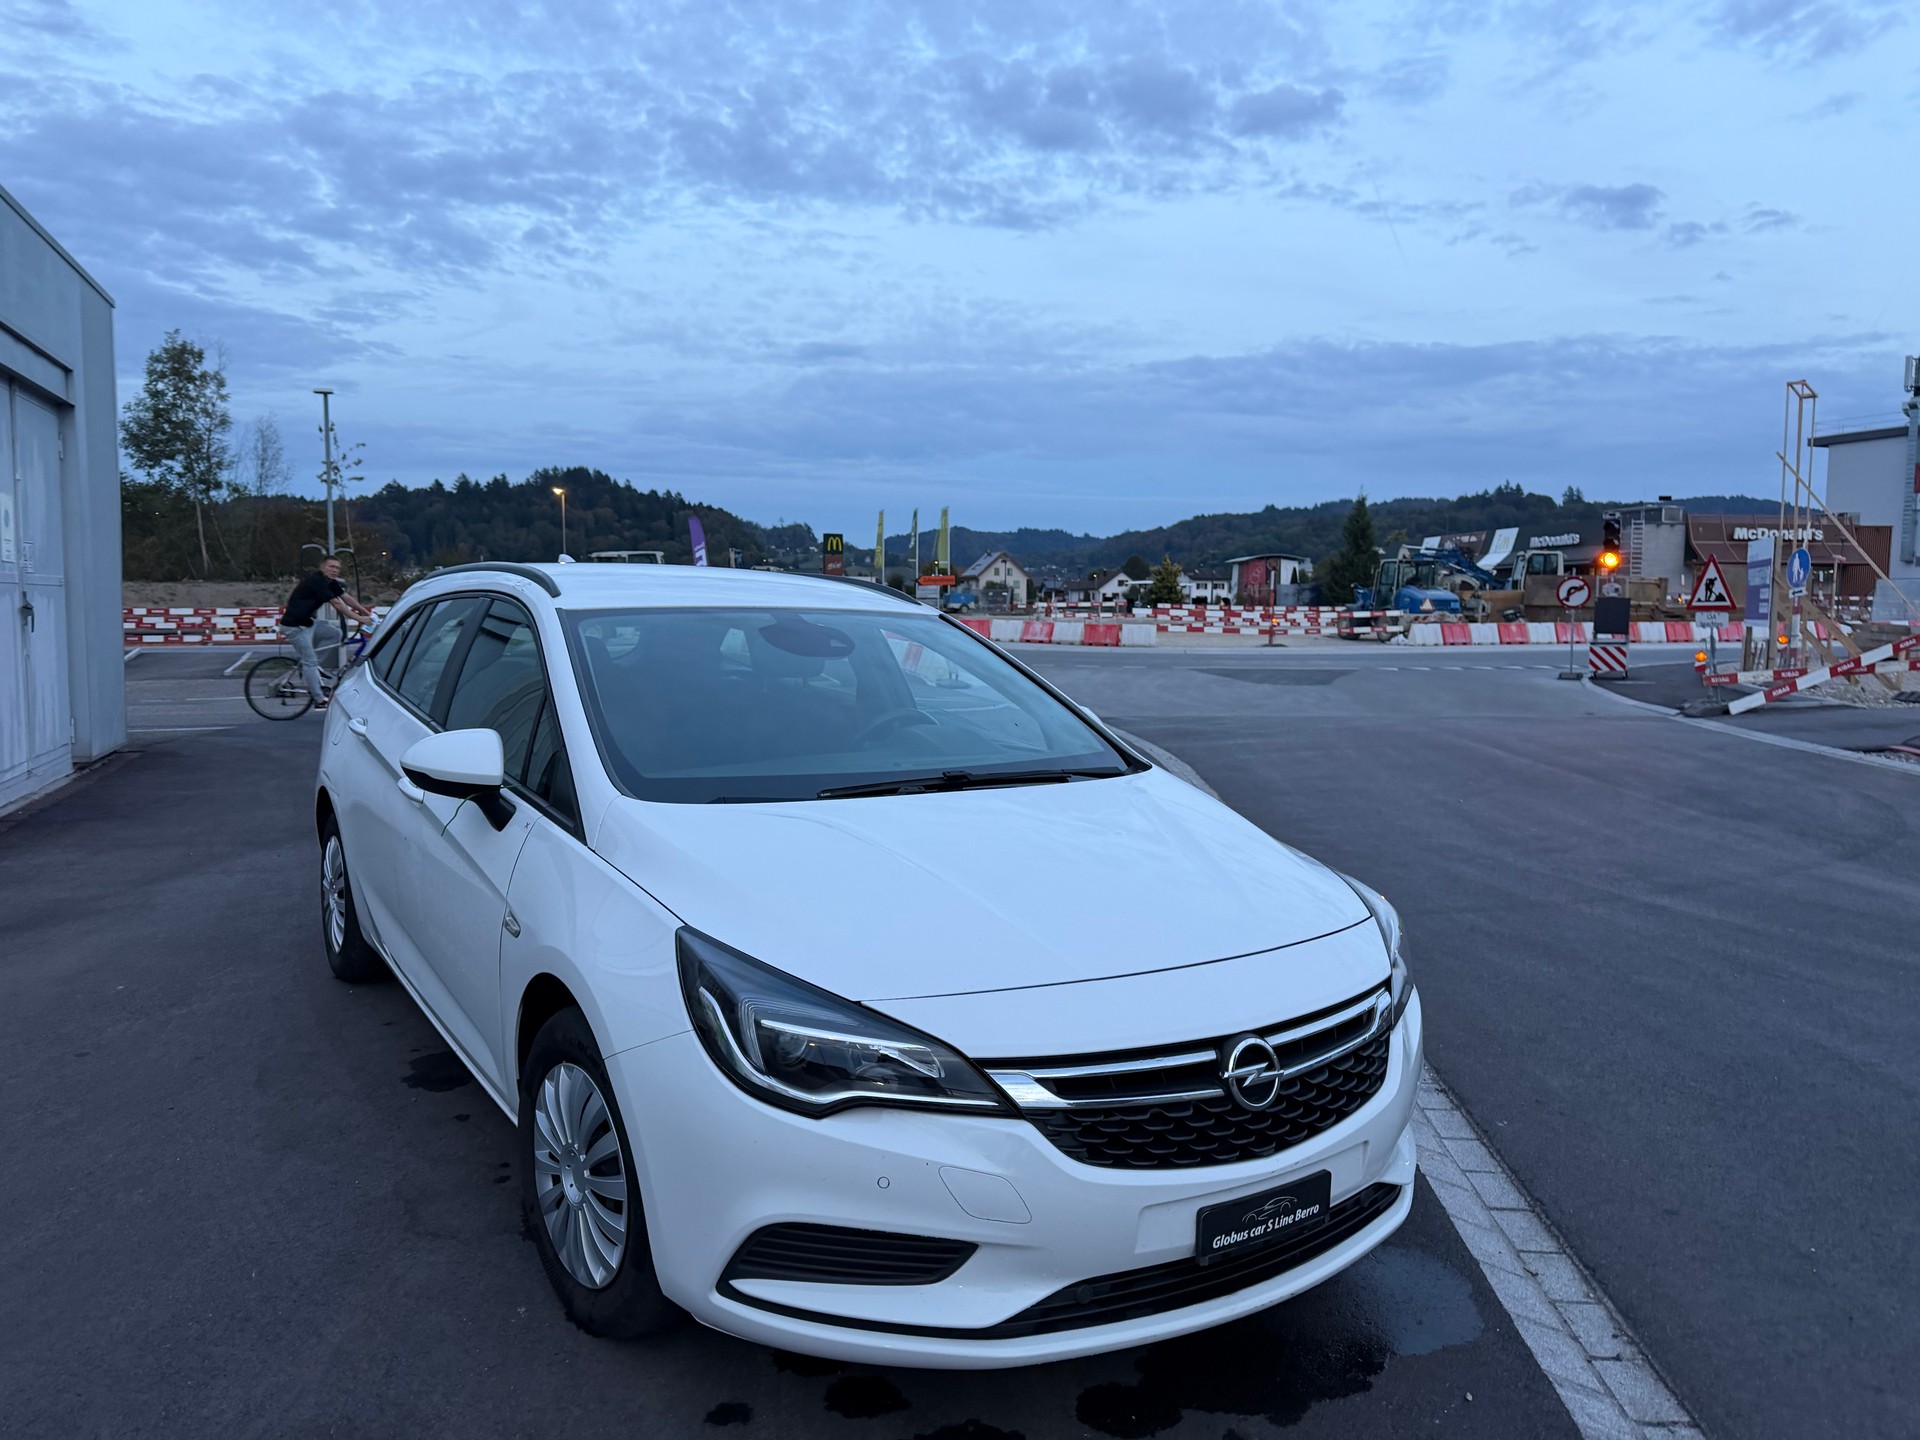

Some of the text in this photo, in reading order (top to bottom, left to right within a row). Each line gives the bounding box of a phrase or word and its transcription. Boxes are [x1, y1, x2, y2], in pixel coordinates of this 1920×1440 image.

[1733, 527, 1823, 541] McDonald's
[1212, 1204, 1320, 1249] Globus car S Line Berro
